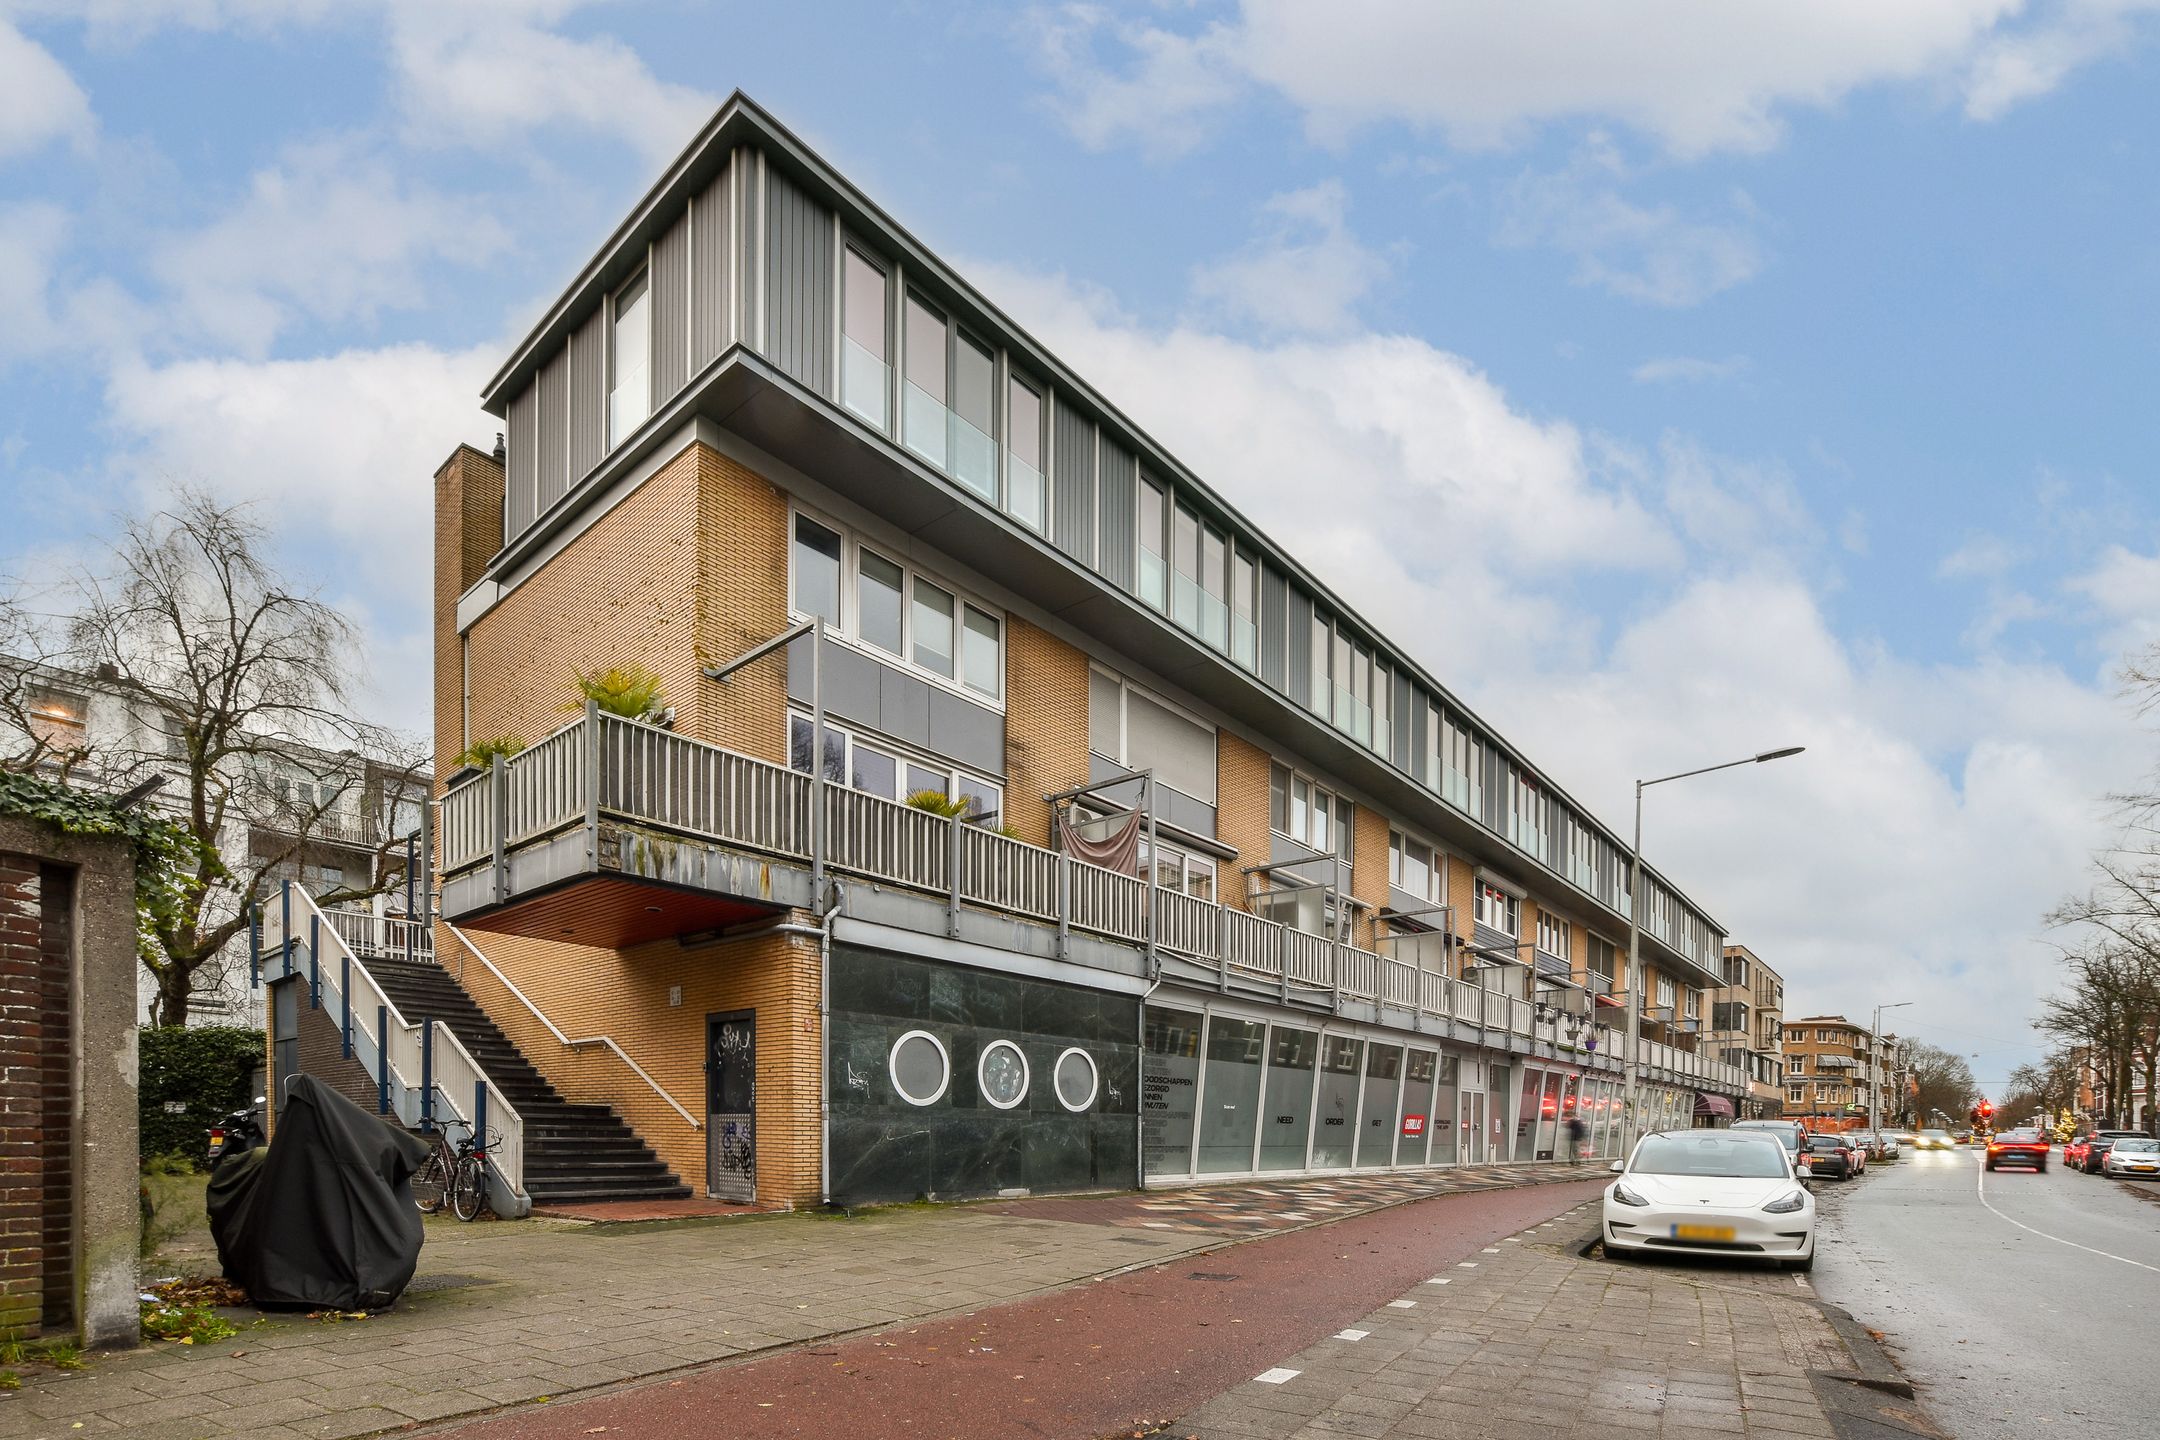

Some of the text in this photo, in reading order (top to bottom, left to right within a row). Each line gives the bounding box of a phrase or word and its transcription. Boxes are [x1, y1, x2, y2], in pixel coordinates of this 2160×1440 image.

[1144, 1075, 1193, 1086] OODSCHAPPEN
[1144, 1084, 1170, 1093] EZORGD
[1277, 1116, 1294, 1125] NEED
[1325, 1117, 1345, 1126] ORDER
